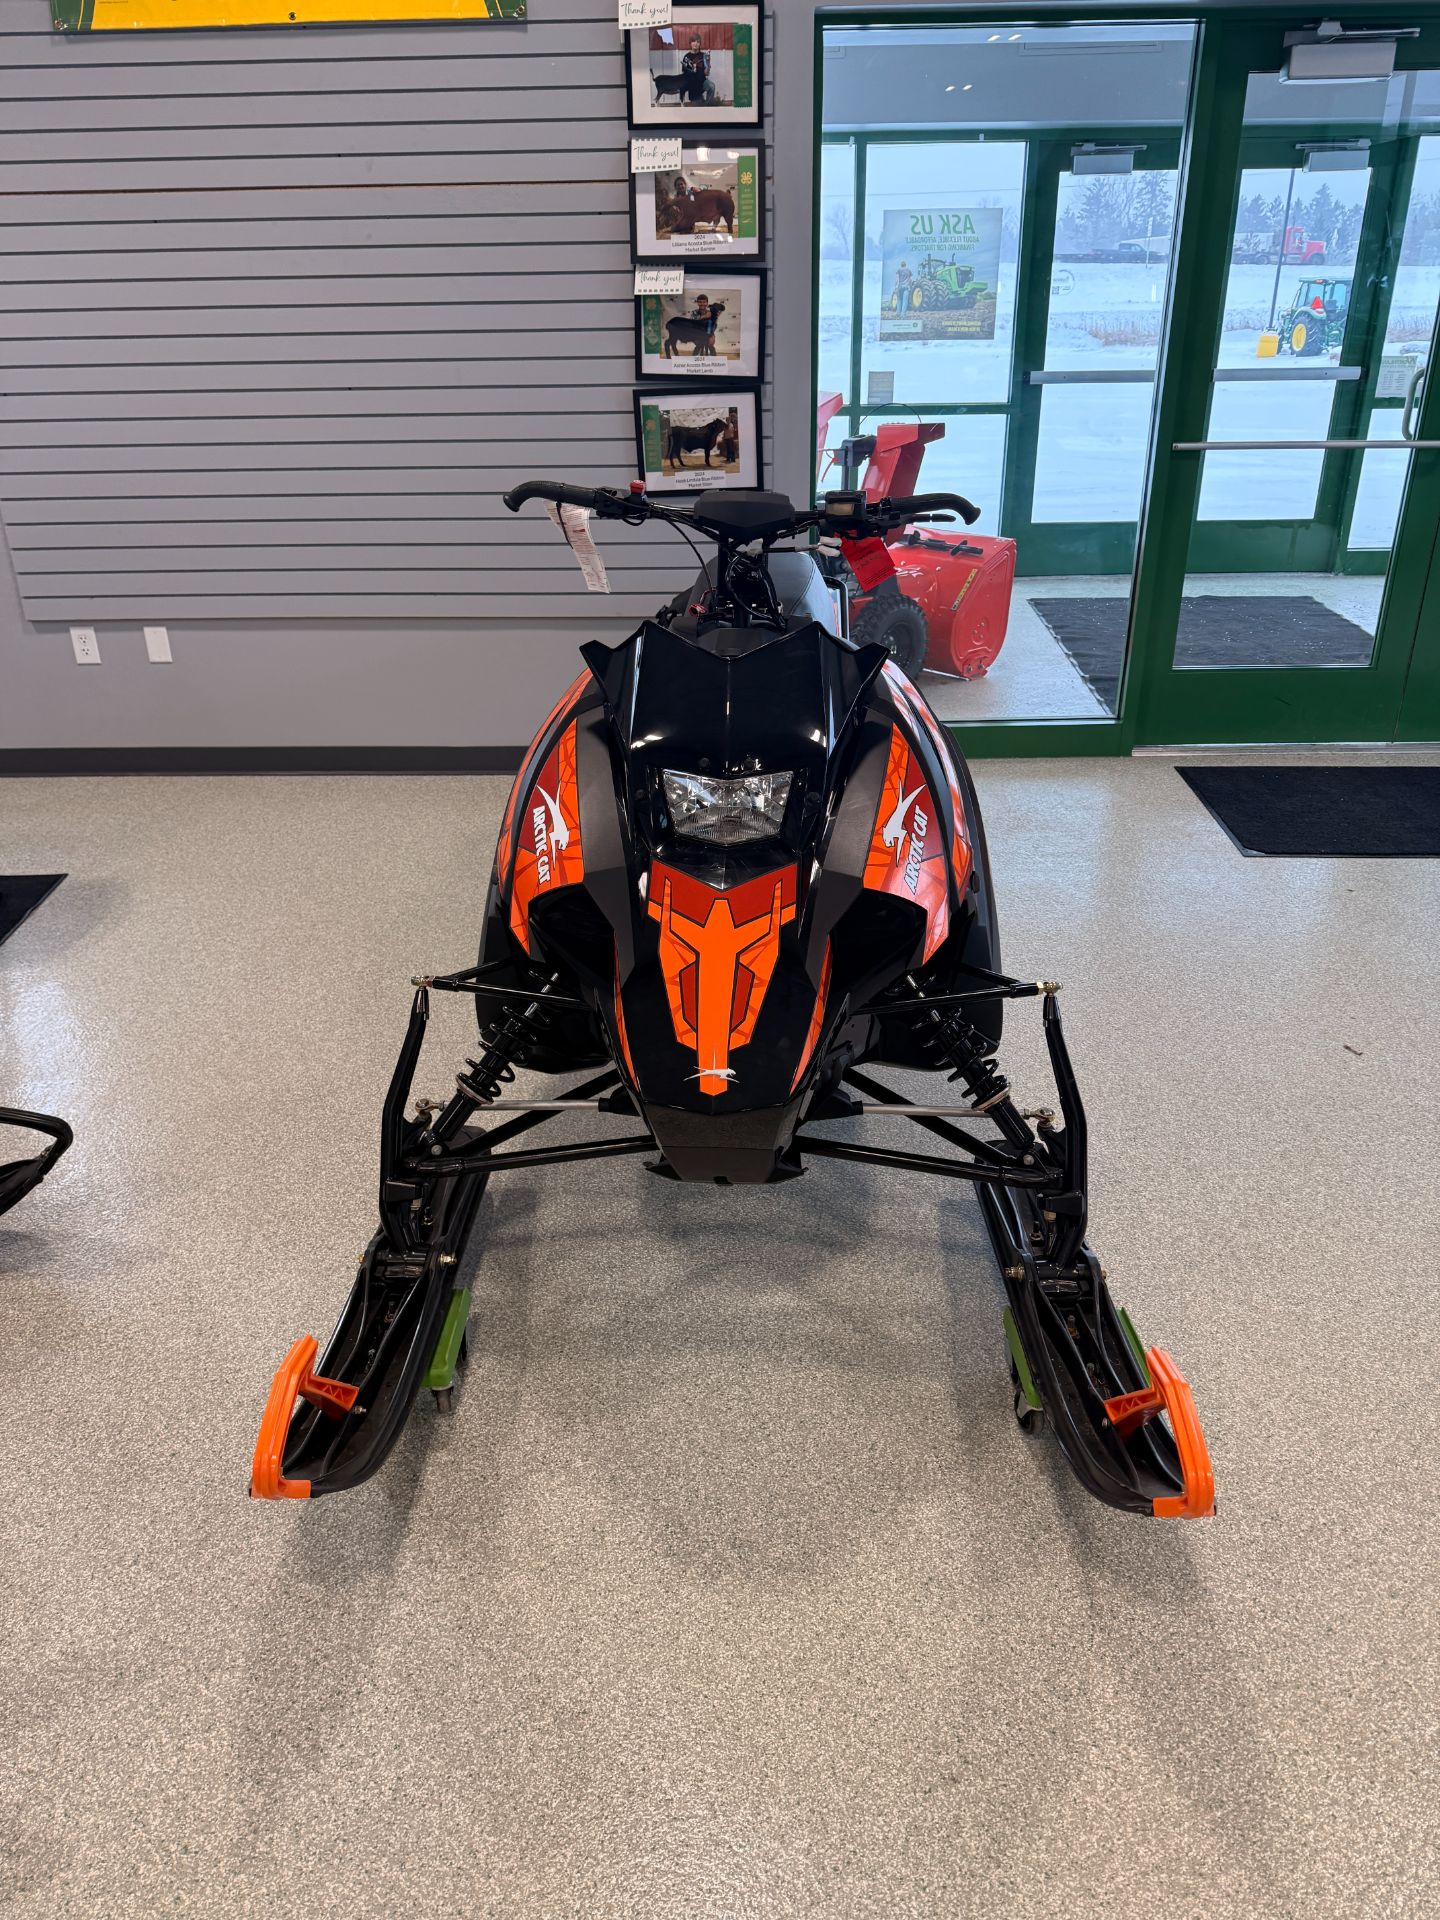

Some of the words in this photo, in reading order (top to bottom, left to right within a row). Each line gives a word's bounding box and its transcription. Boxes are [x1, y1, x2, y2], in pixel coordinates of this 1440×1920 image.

[621, 3, 647, 17] Thank
[633, 146, 658, 160] Thank
[638, 270, 660, 284] Thank
[533, 805, 547, 856] ARCTIC
[913, 805, 928, 837] CAT
[537, 856, 551, 885] CAT
[904, 833, 924, 895] ARCTIC
